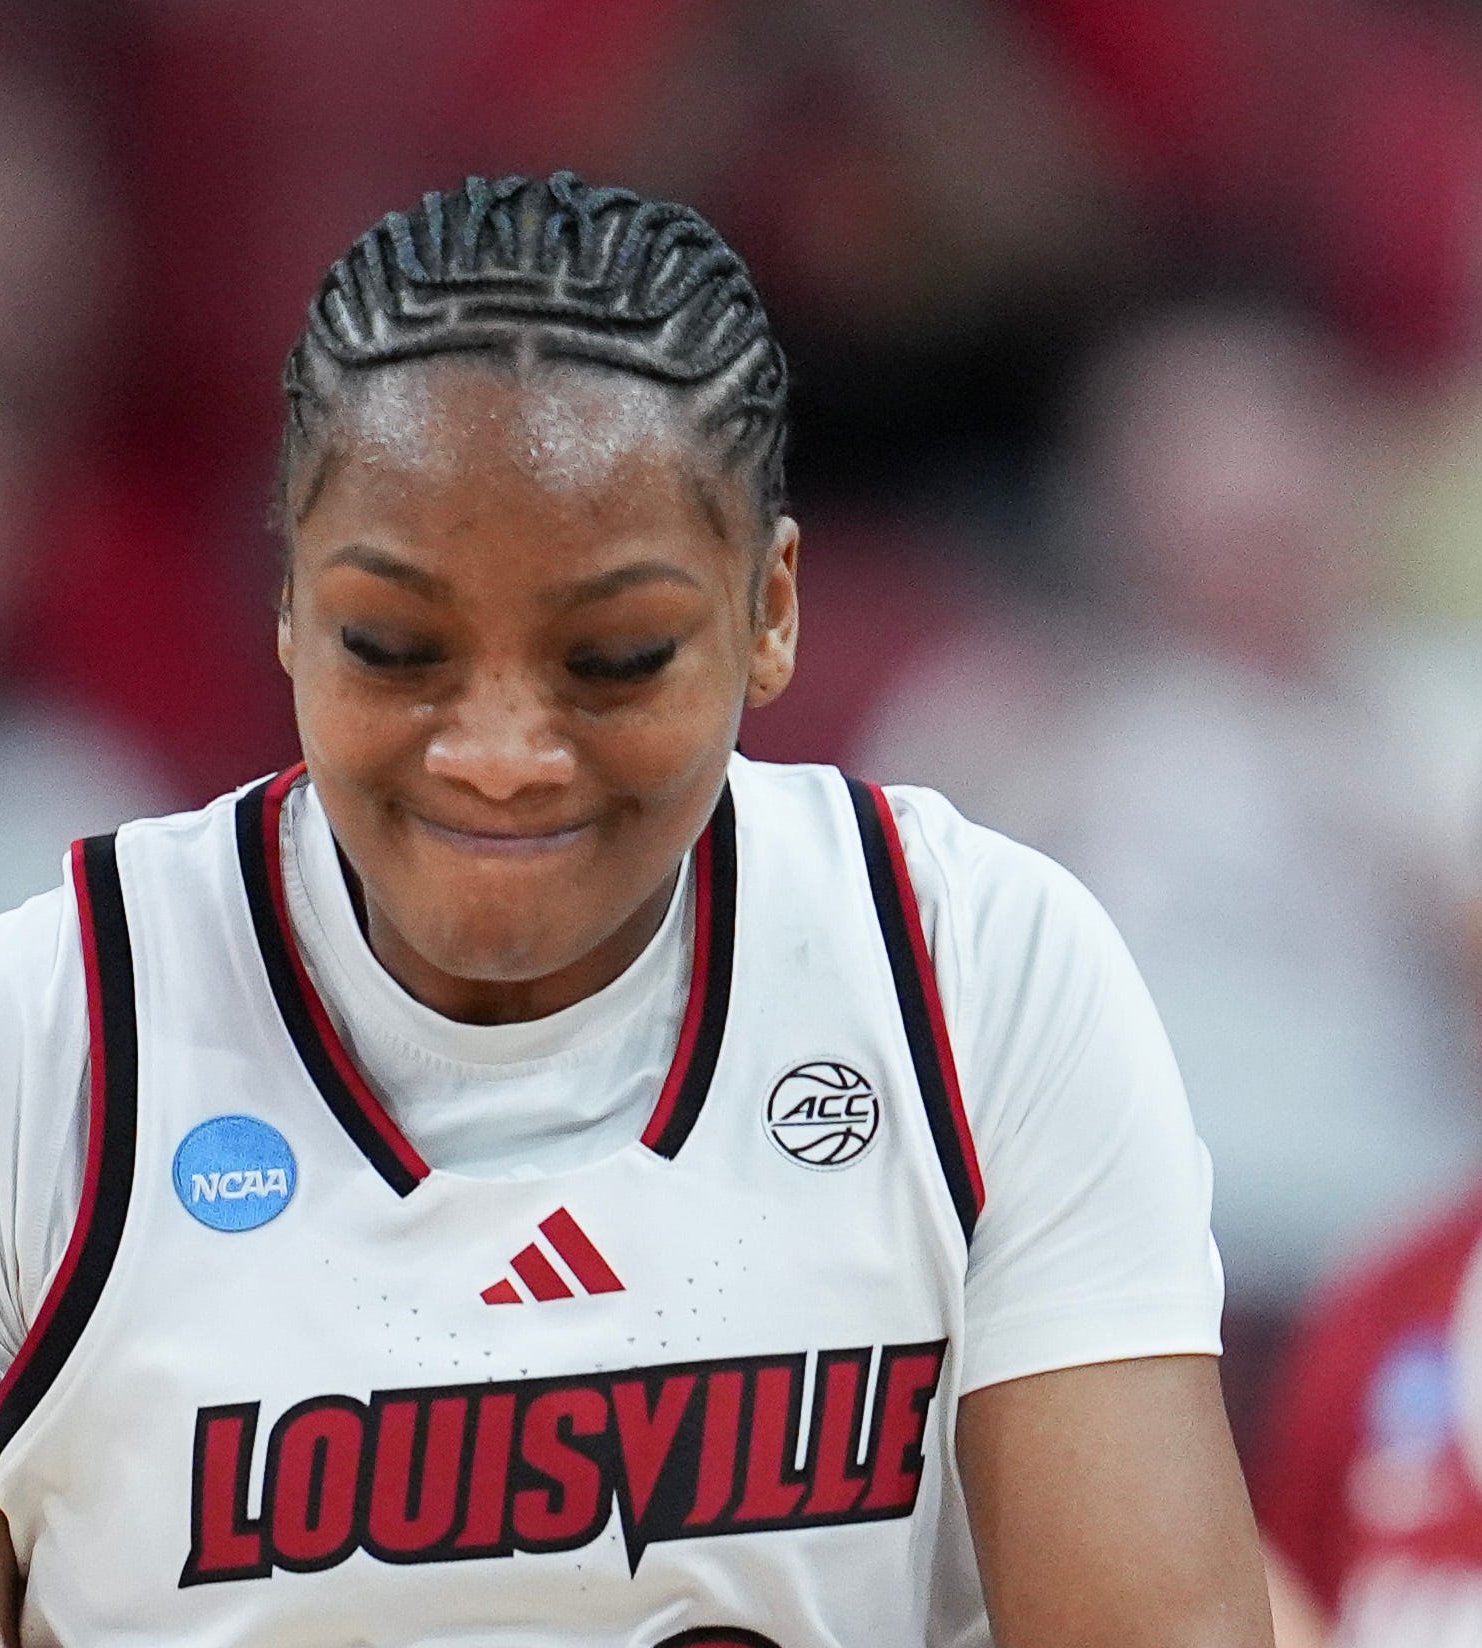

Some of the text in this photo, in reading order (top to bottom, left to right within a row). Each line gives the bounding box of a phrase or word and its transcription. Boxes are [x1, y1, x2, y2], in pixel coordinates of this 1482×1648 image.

[780, 1093, 872, 1120] ACC
[191, 1167, 288, 1203] NCAA
[178, 1337, 949, 1589] LOUISVILLE
